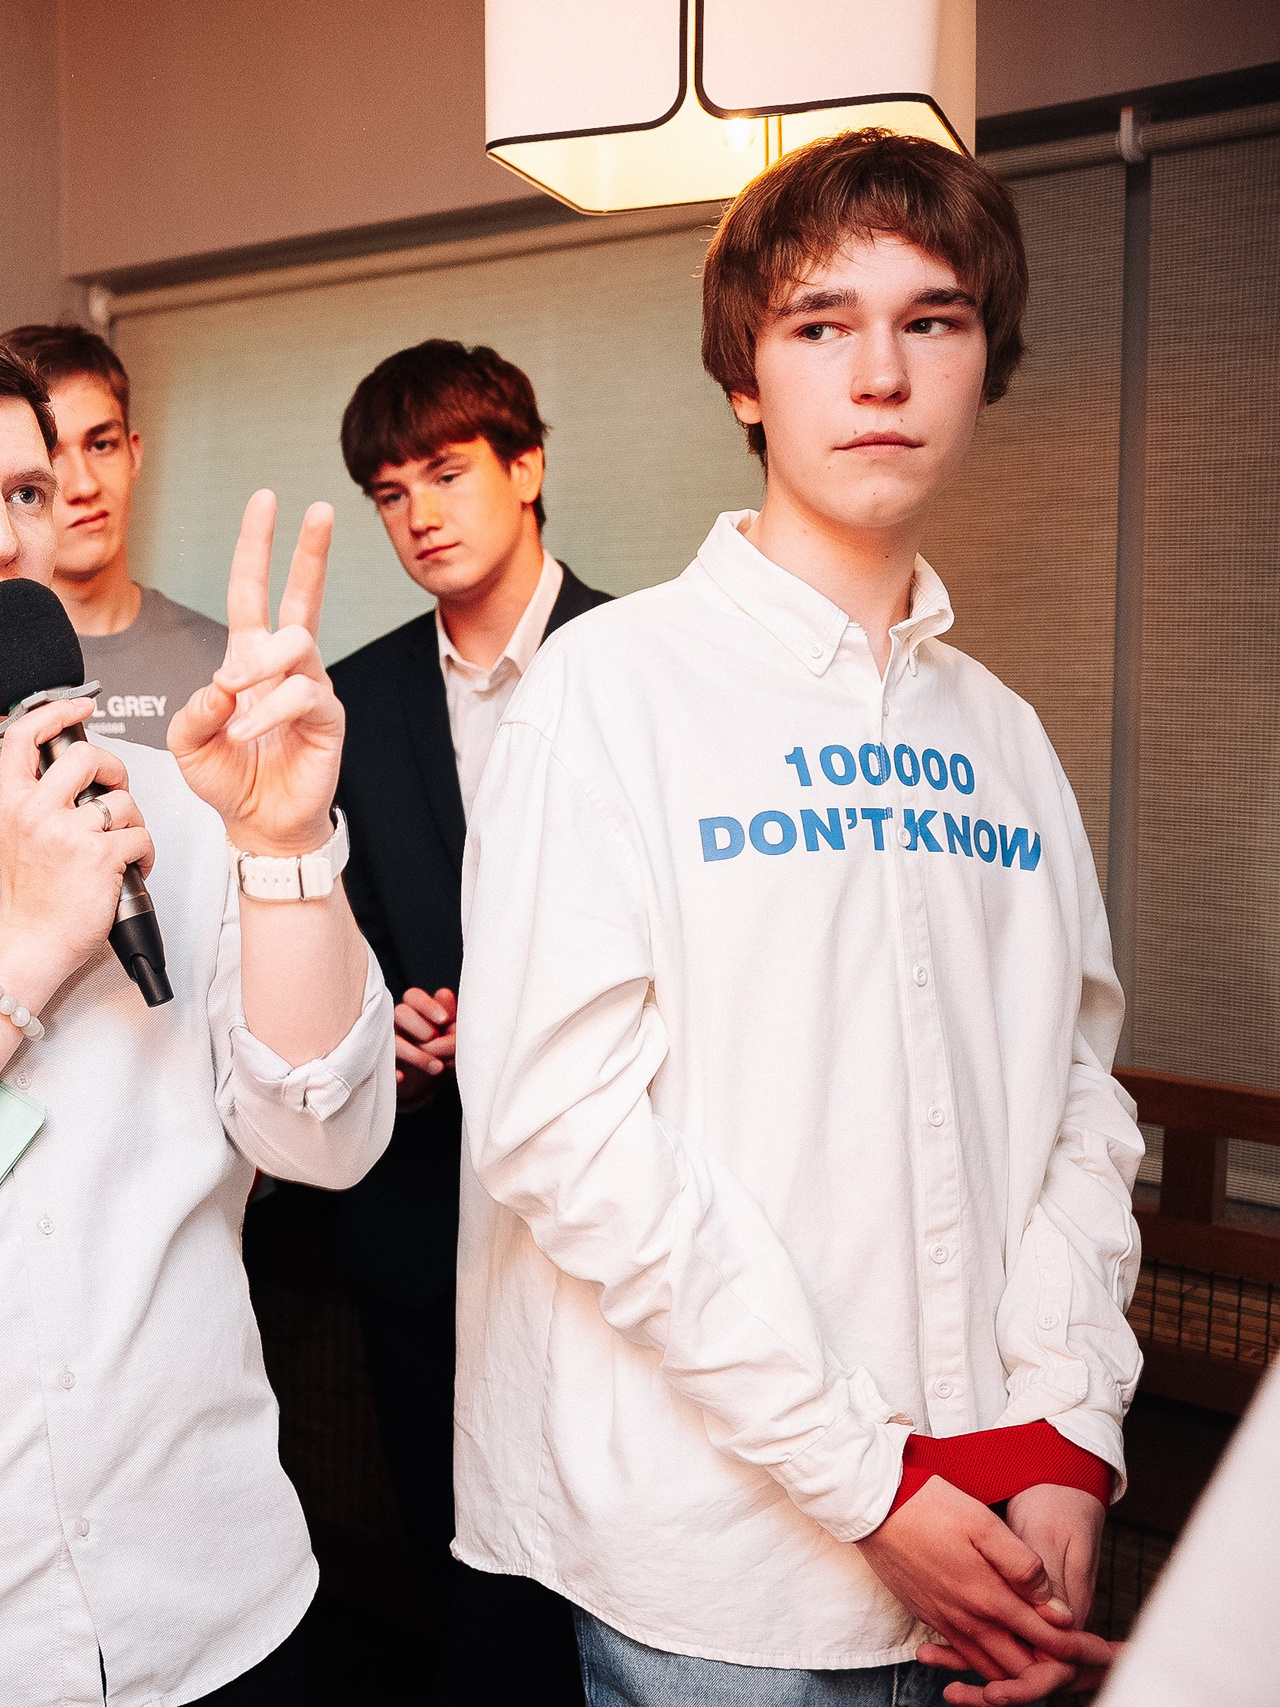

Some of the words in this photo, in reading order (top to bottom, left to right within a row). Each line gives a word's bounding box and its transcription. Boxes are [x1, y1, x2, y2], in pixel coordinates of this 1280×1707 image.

[106, 694, 168, 718] GREY
[784, 741, 975, 795] 100000
[698, 806, 893, 863] DON'T
[902, 807, 1042, 872] KNOW
